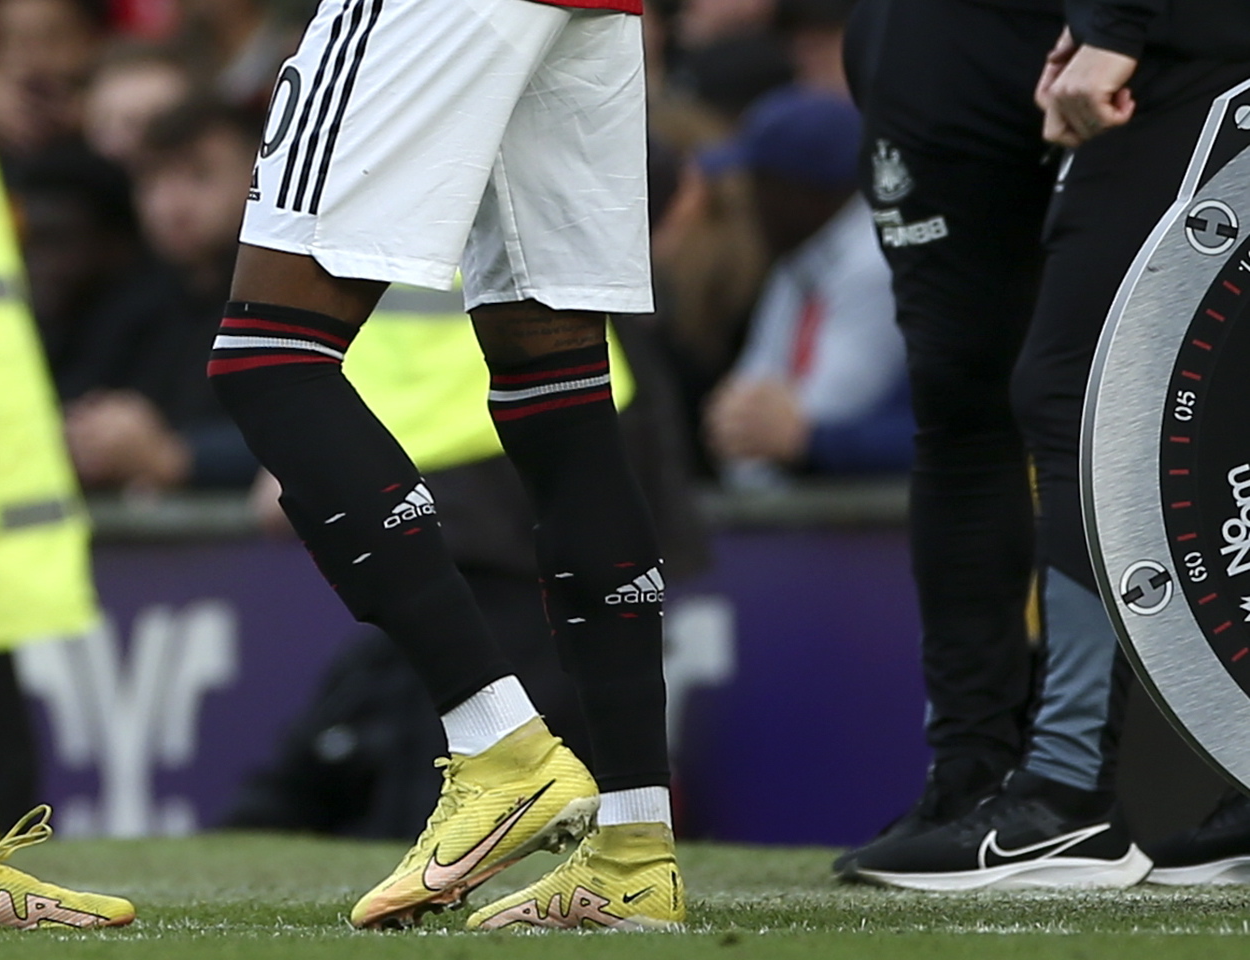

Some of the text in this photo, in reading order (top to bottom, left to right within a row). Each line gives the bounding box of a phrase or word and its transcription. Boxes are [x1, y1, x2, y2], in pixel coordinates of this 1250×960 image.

[1174, 390, 1196, 421] 05
[383, 504, 437, 529] adid
[1184, 551, 1208, 582] 60
